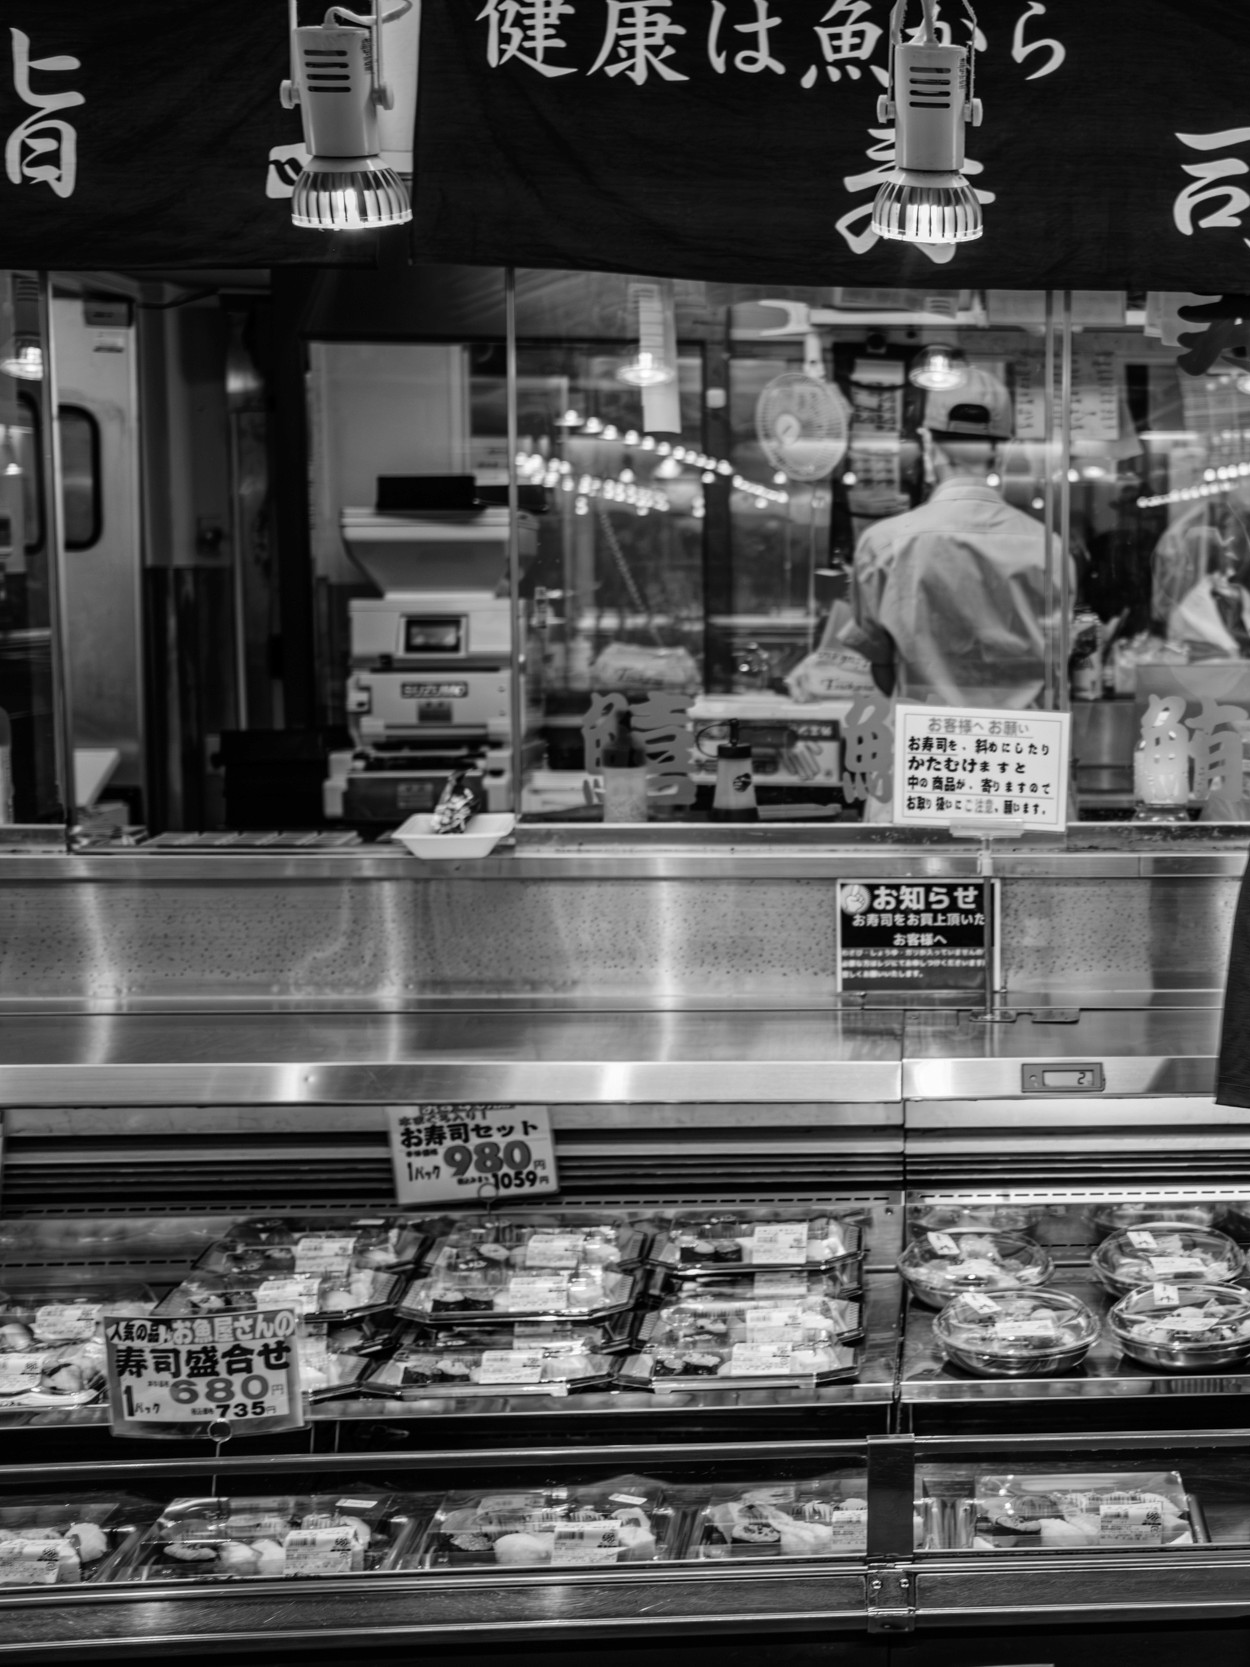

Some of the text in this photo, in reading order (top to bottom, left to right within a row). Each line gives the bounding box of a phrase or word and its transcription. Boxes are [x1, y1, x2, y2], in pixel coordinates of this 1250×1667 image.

[5, 27, 86, 199] 旨
[928, 718, 1029, 737] お客様へ お願い
[908, 756, 1026, 774] かたむけますと
[873, 885, 979, 910] お知らせ
[852, 913, 986, 927] お寿司をお買上頂いた
[893, 933, 947, 946] お客様へ
[400, 1120, 538, 1148] お寿司セット
[173, 1311, 295, 1345] お魚屋さんの
[115, 1340, 291, 1378] 寿司盛合せ
